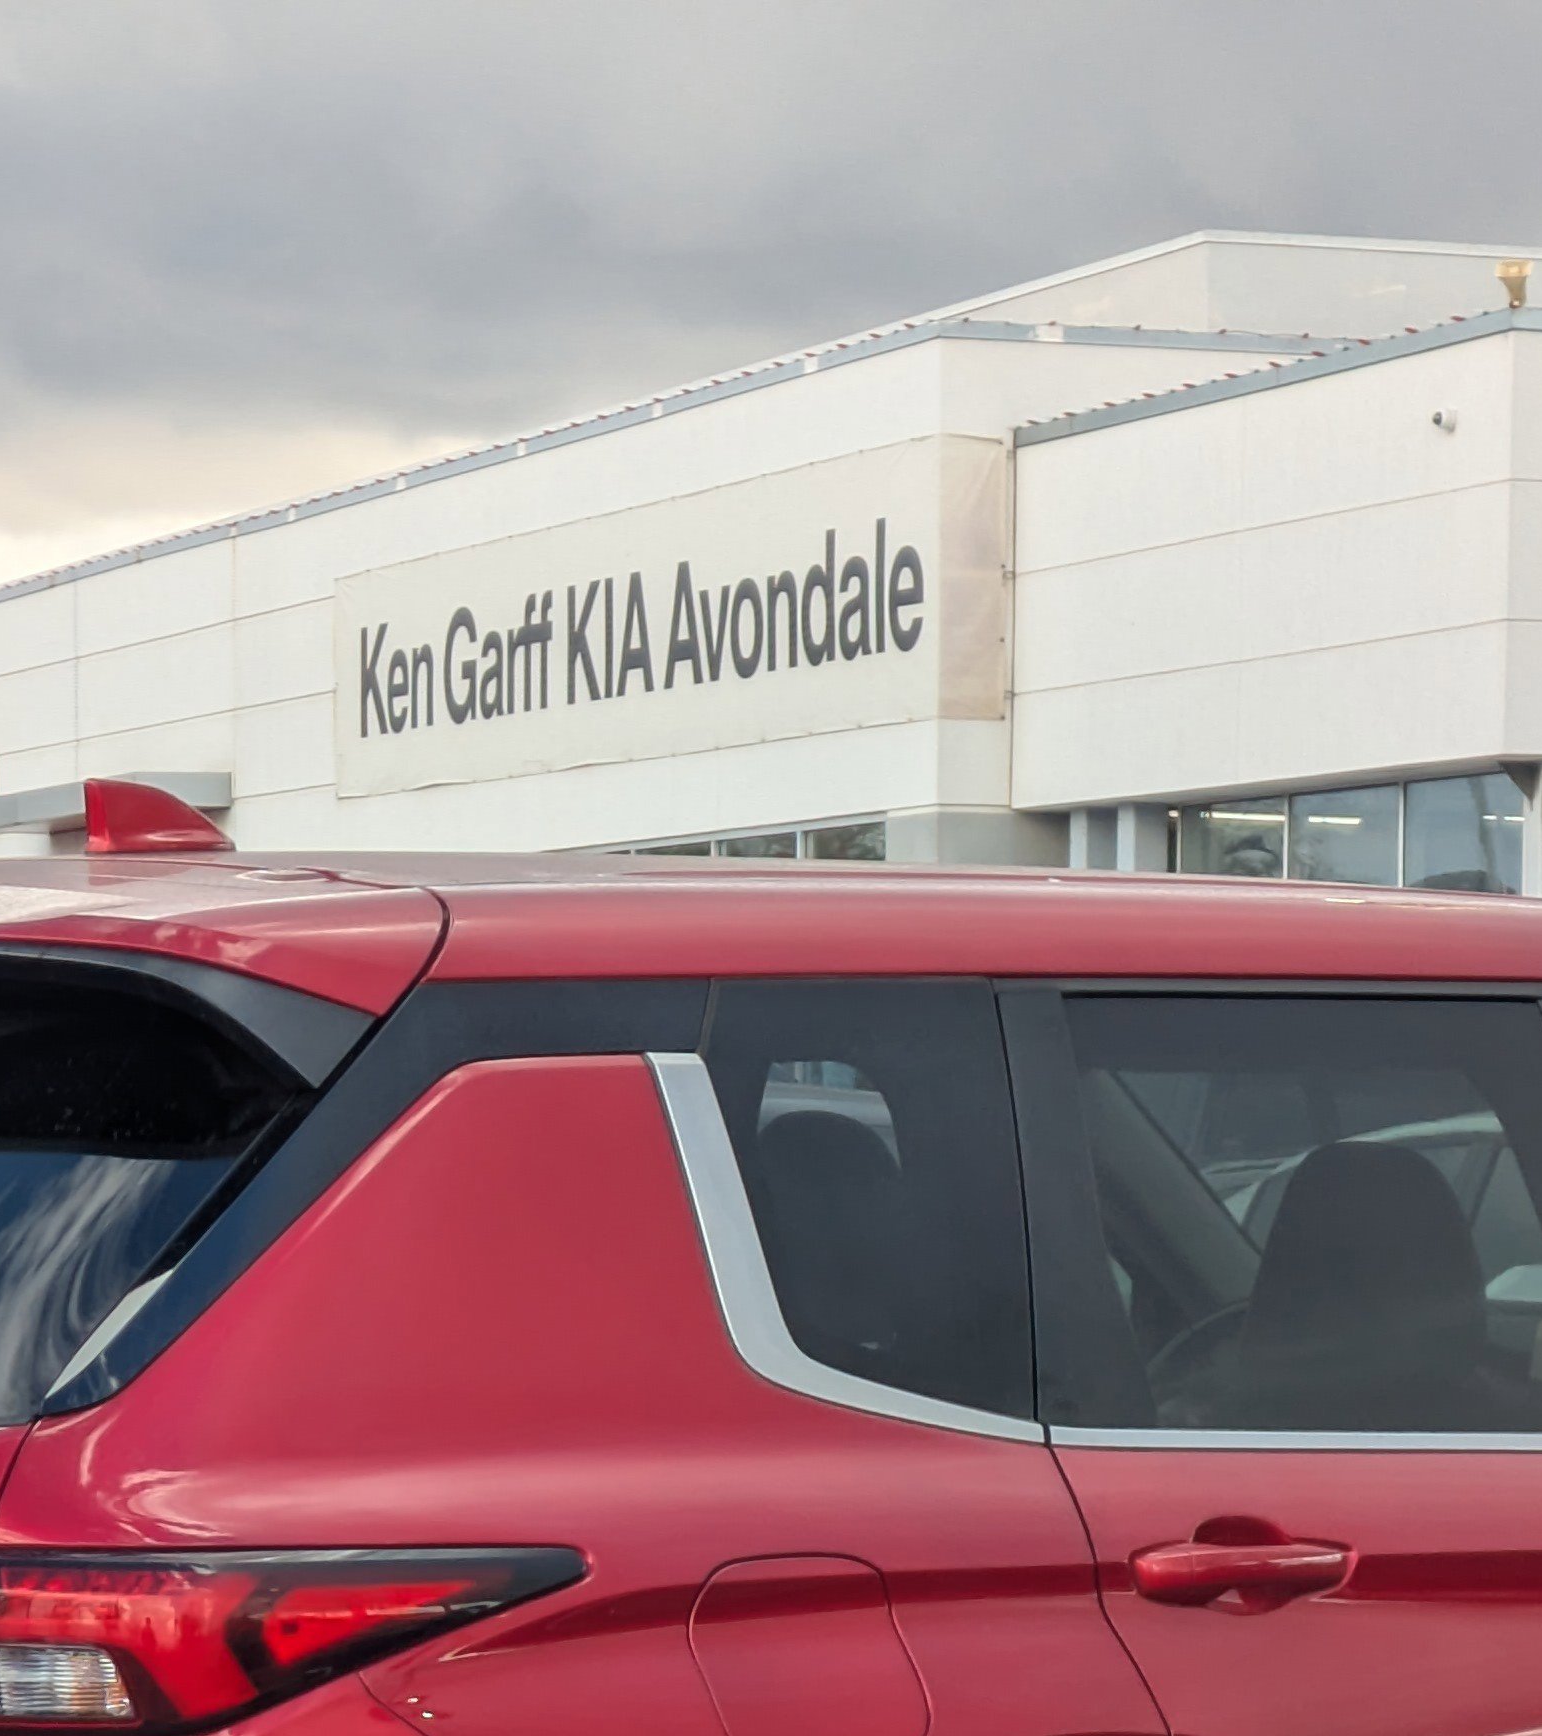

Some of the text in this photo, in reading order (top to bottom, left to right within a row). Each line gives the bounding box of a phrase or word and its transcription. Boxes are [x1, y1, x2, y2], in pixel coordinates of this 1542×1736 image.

[360, 517, 925, 738] Ken Garff KIA Avondale
